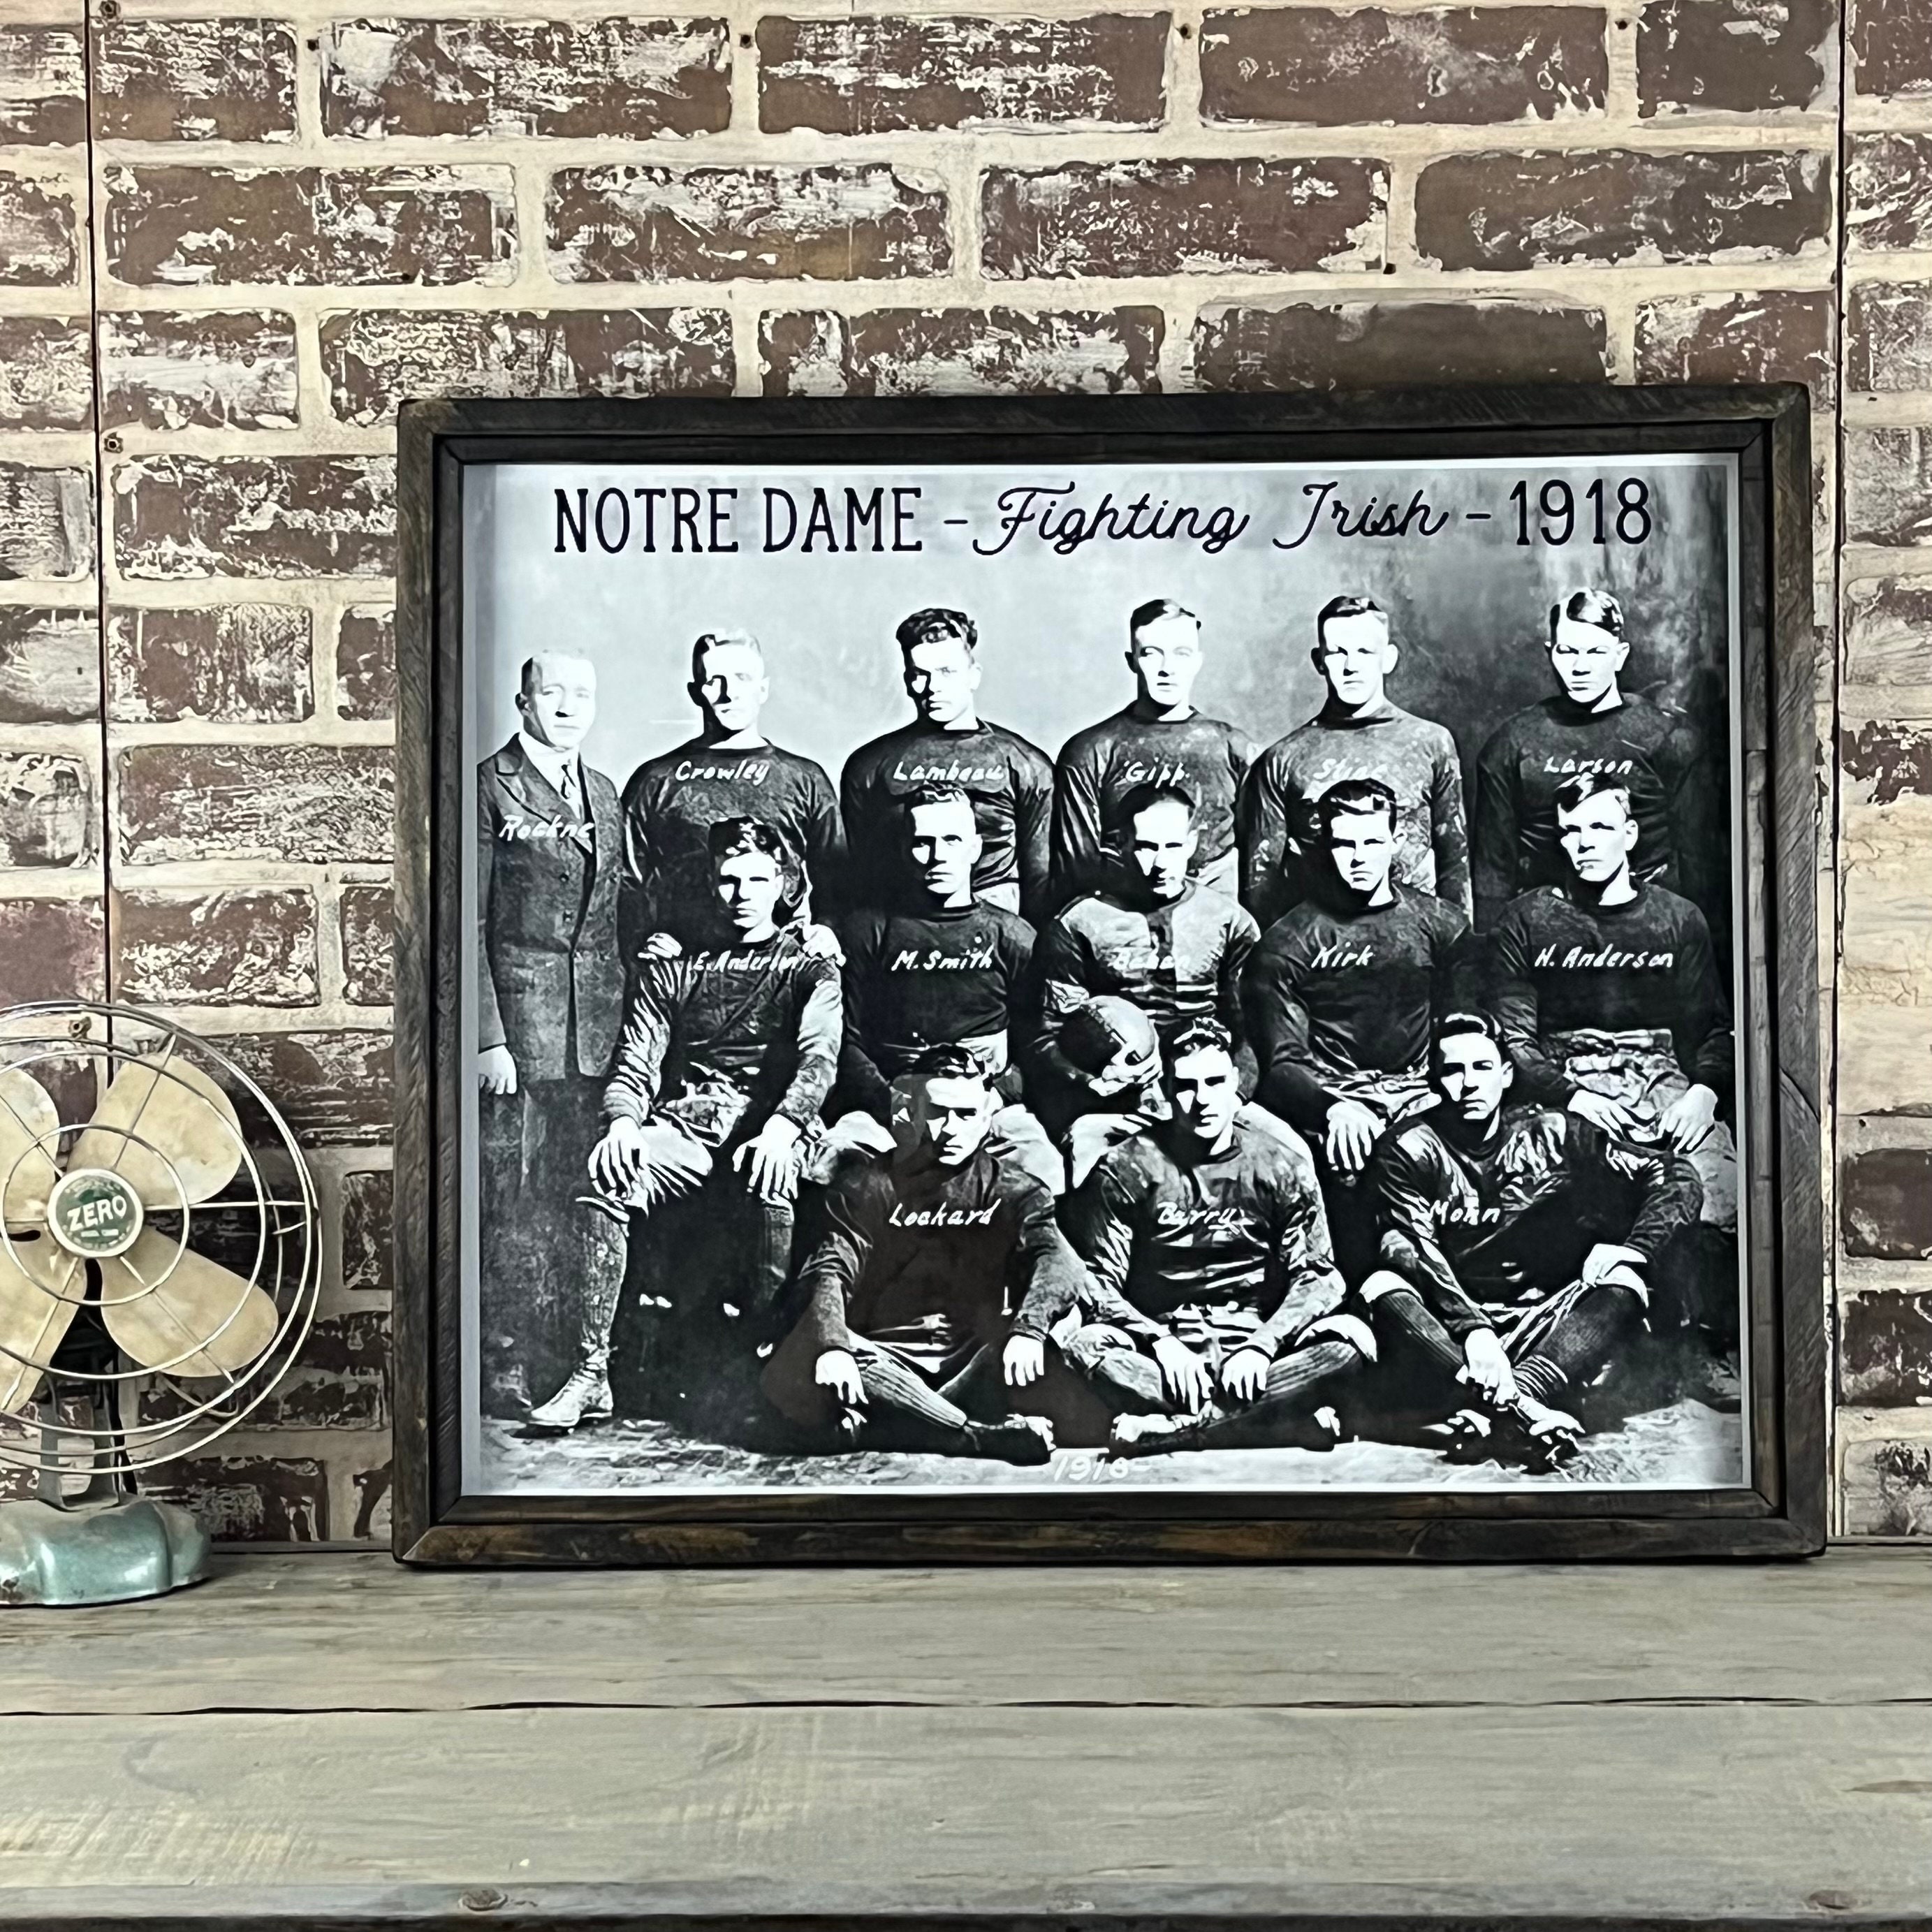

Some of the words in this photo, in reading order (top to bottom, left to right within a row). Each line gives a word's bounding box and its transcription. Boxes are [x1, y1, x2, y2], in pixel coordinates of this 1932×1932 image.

[554, 488, 739, 554] NOTRE
[763, 488, 922, 553] DAME
[972, 481, 1250, 556] Fighting
[1273, 481, 1449, 549] Irish
[1509, 478, 1652, 546] 1918
[675, 761, 769, 786] Crowley
[1544, 756, 1633, 775] Larson
[1311, 942, 1373, 968] Kirk
[1562, 943, 1674, 969] Anderson
[66, 1195, 127, 1232] ZERO
[1053, 1455, 1129, 1482] 1918
